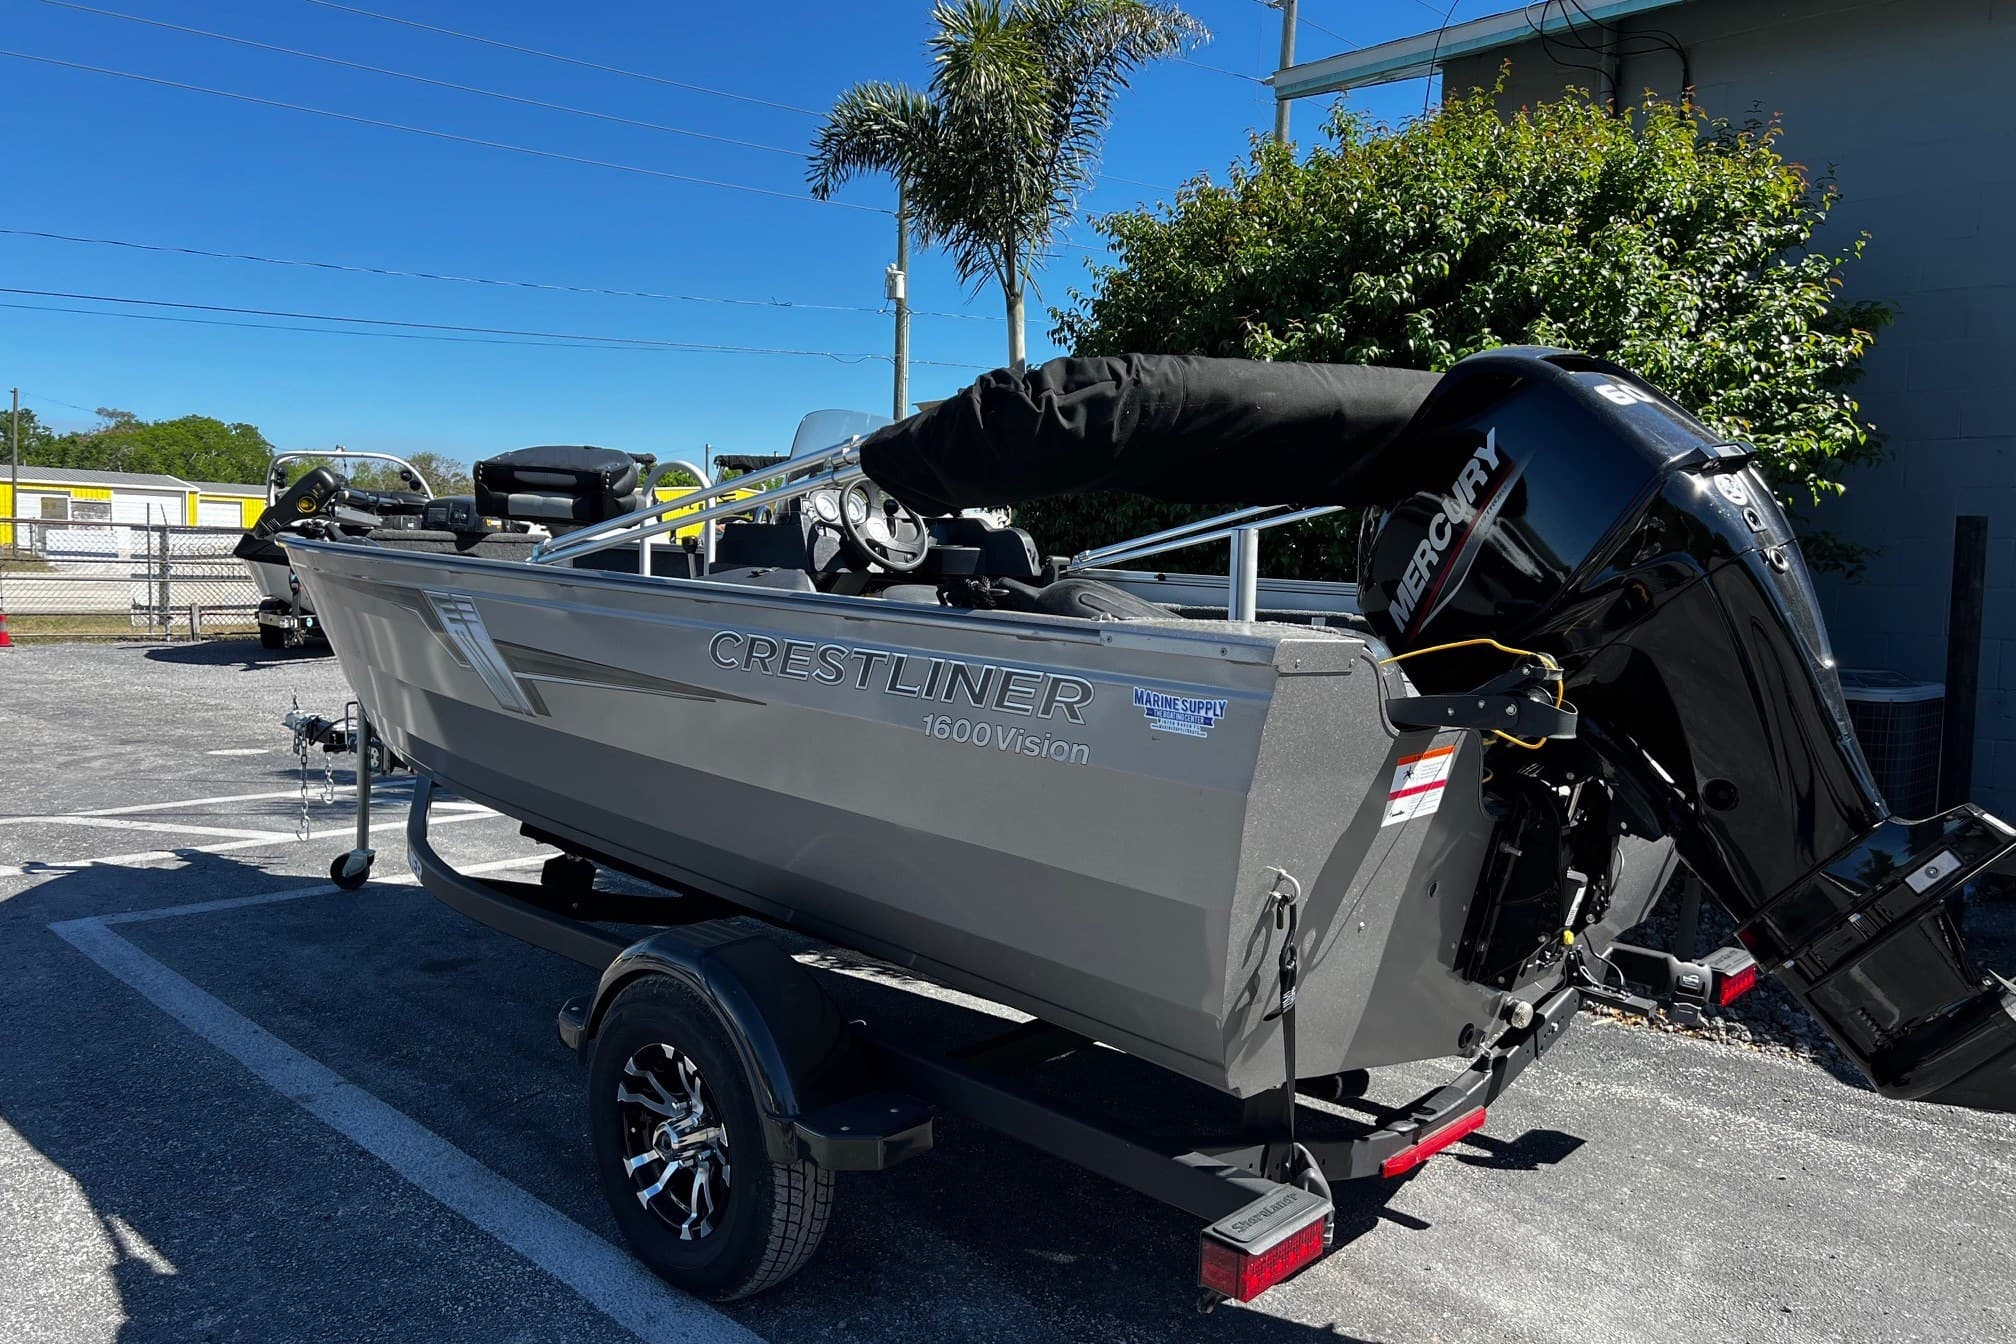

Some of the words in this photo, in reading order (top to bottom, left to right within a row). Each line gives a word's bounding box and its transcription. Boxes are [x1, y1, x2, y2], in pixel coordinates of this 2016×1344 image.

[1593, 384, 1656, 406] 60
[1388, 426, 1500, 634] MERCURY
[708, 630, 1095, 725] CRESTLINER
[1134, 687, 1180, 711] MARINE
[1180, 698, 1227, 718] SUPPLY
[922, 713, 992, 747] 1600
[994, 725, 1091, 765] Vision
